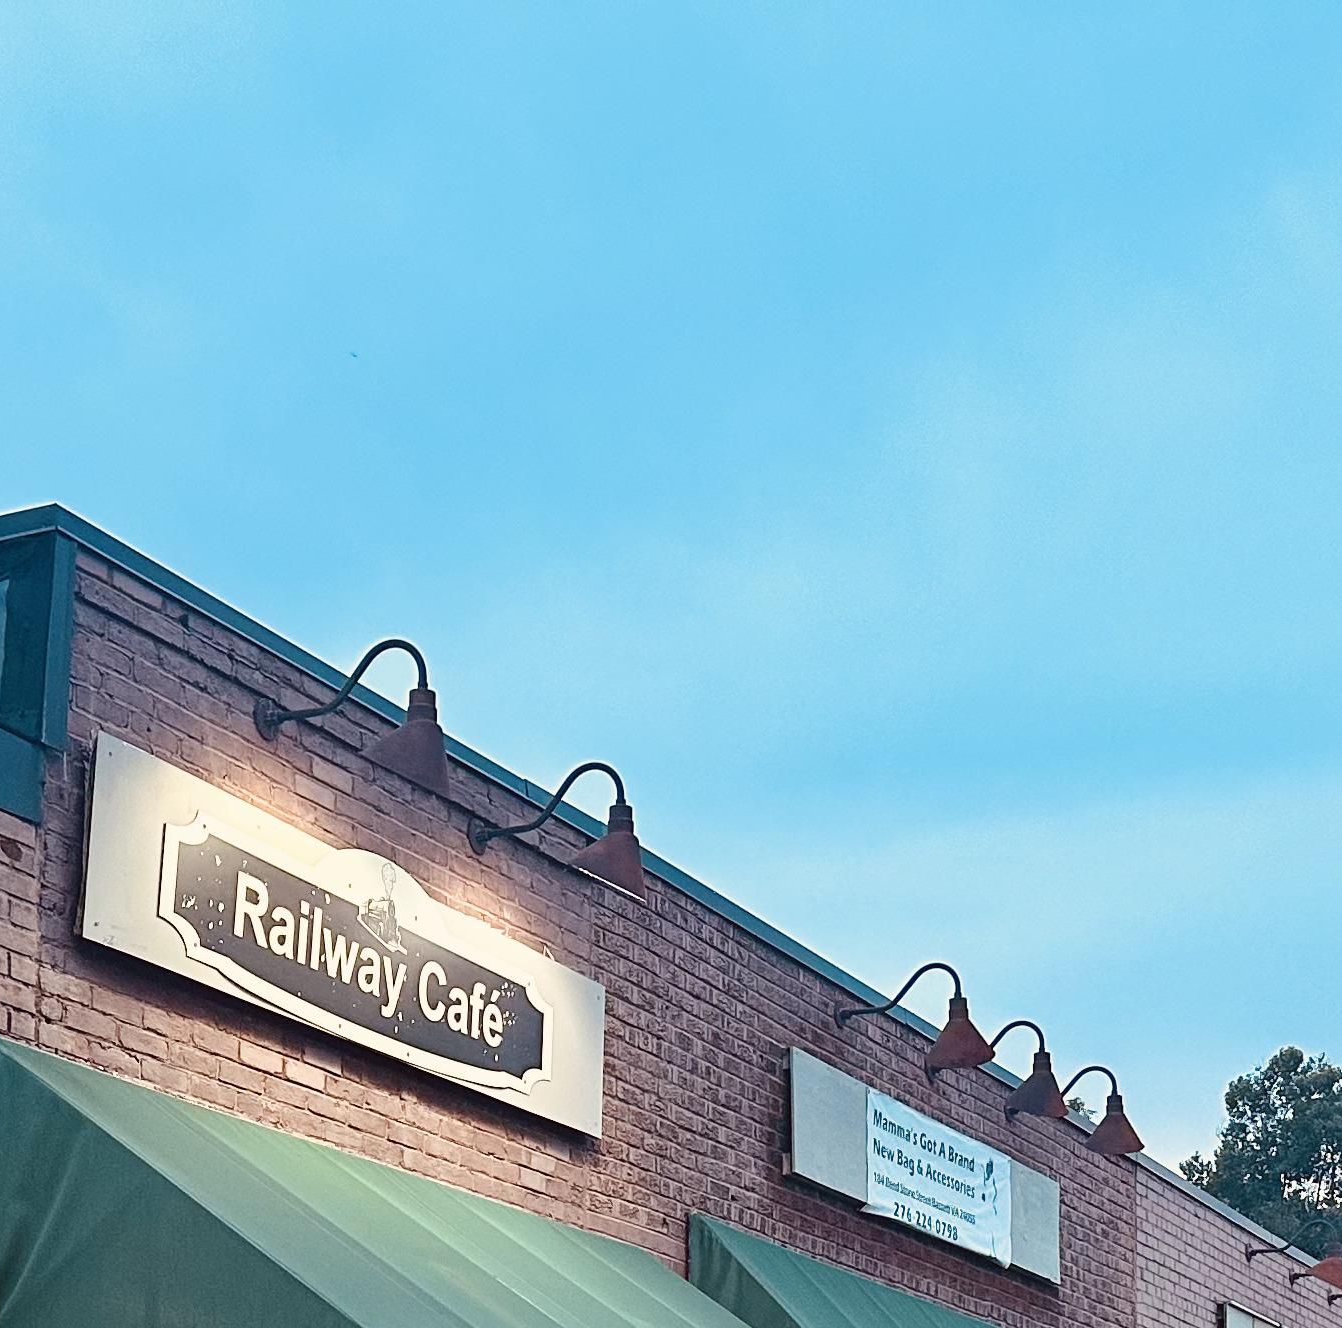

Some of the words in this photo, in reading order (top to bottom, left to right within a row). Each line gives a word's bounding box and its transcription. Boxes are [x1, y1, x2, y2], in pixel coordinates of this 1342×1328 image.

[233, 870, 407, 1018] Railway
[418, 960, 504, 1048] Café
[873, 1109, 917, 1145] Mamma's
[920, 1132, 937, 1155] Got
[939, 1142, 946, 1160] A
[948, 1145, 975, 1172] Brand
[873, 1138, 895, 1162] New
[897, 1149, 915, 1176] Bag
[917, 1159, 924, 1176] &
[925, 1163, 975, 1199] Accessories
